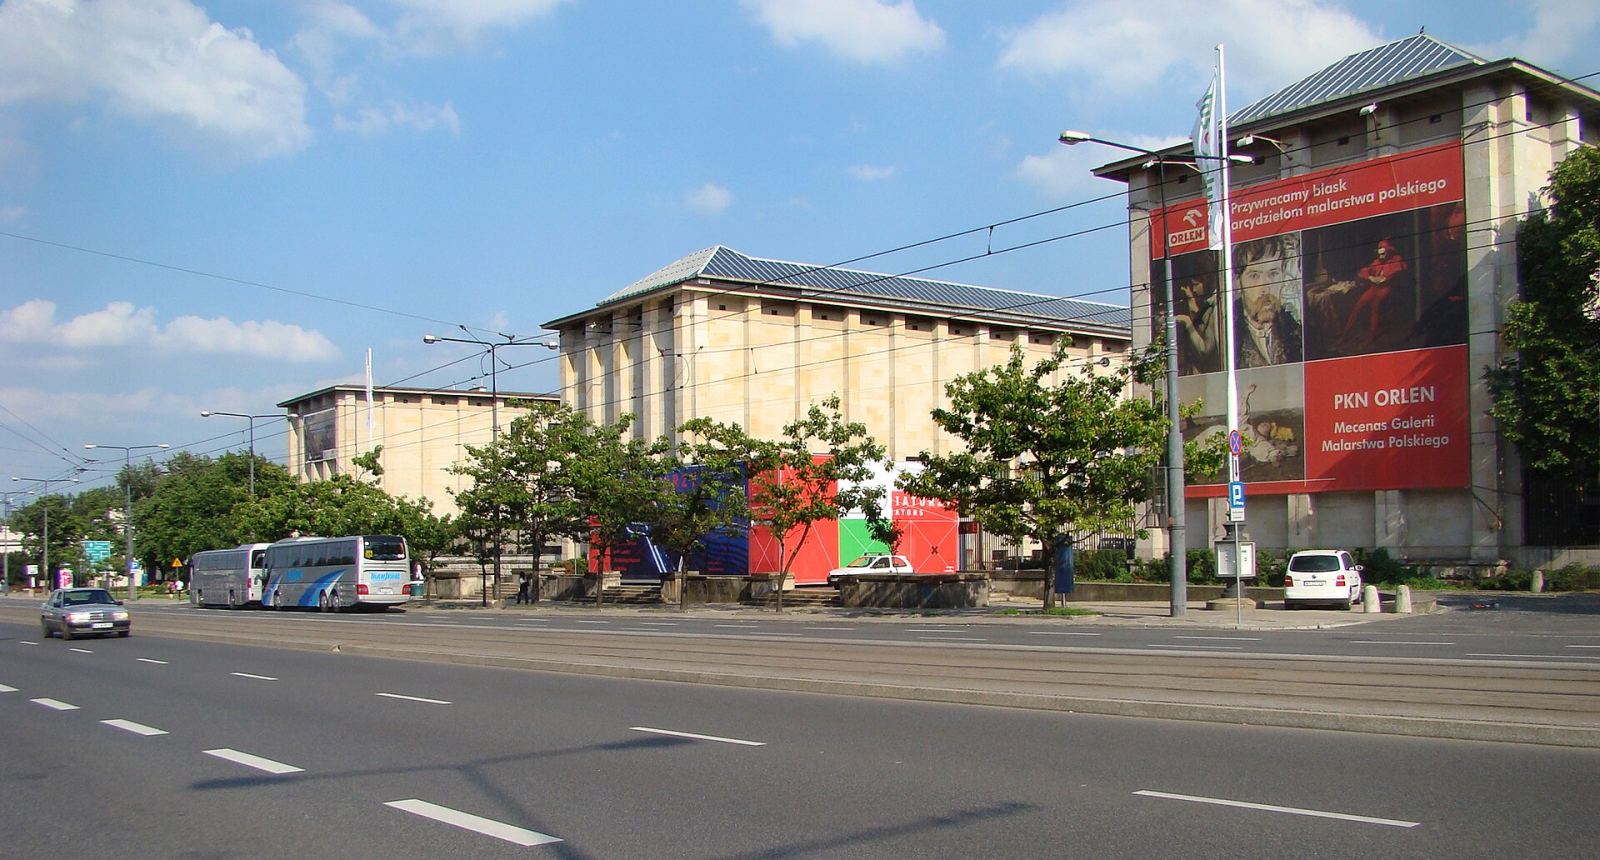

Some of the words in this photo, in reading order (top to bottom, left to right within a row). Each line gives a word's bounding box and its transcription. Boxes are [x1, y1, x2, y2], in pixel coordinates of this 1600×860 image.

[1231, 189, 1310, 214] Przywracamy
[1313, 179, 1347, 197] blask
[1231, 208, 1303, 230] arcydziełom
[1307, 192, 1375, 215] malarstwa
[1379, 179, 1447, 204] polskiego
[1170, 229, 1203, 244] ORLEN
[1334, 391, 1368, 410] PKN
[1374, 386, 1434, 406] ORLEN
[1334, 421, 1387, 434] Mecenas
[1392, 415, 1434, 430] Galerii
[1322, 439, 1385, 451] Malarstwa
[1388, 433, 1449, 448] Polskiego
